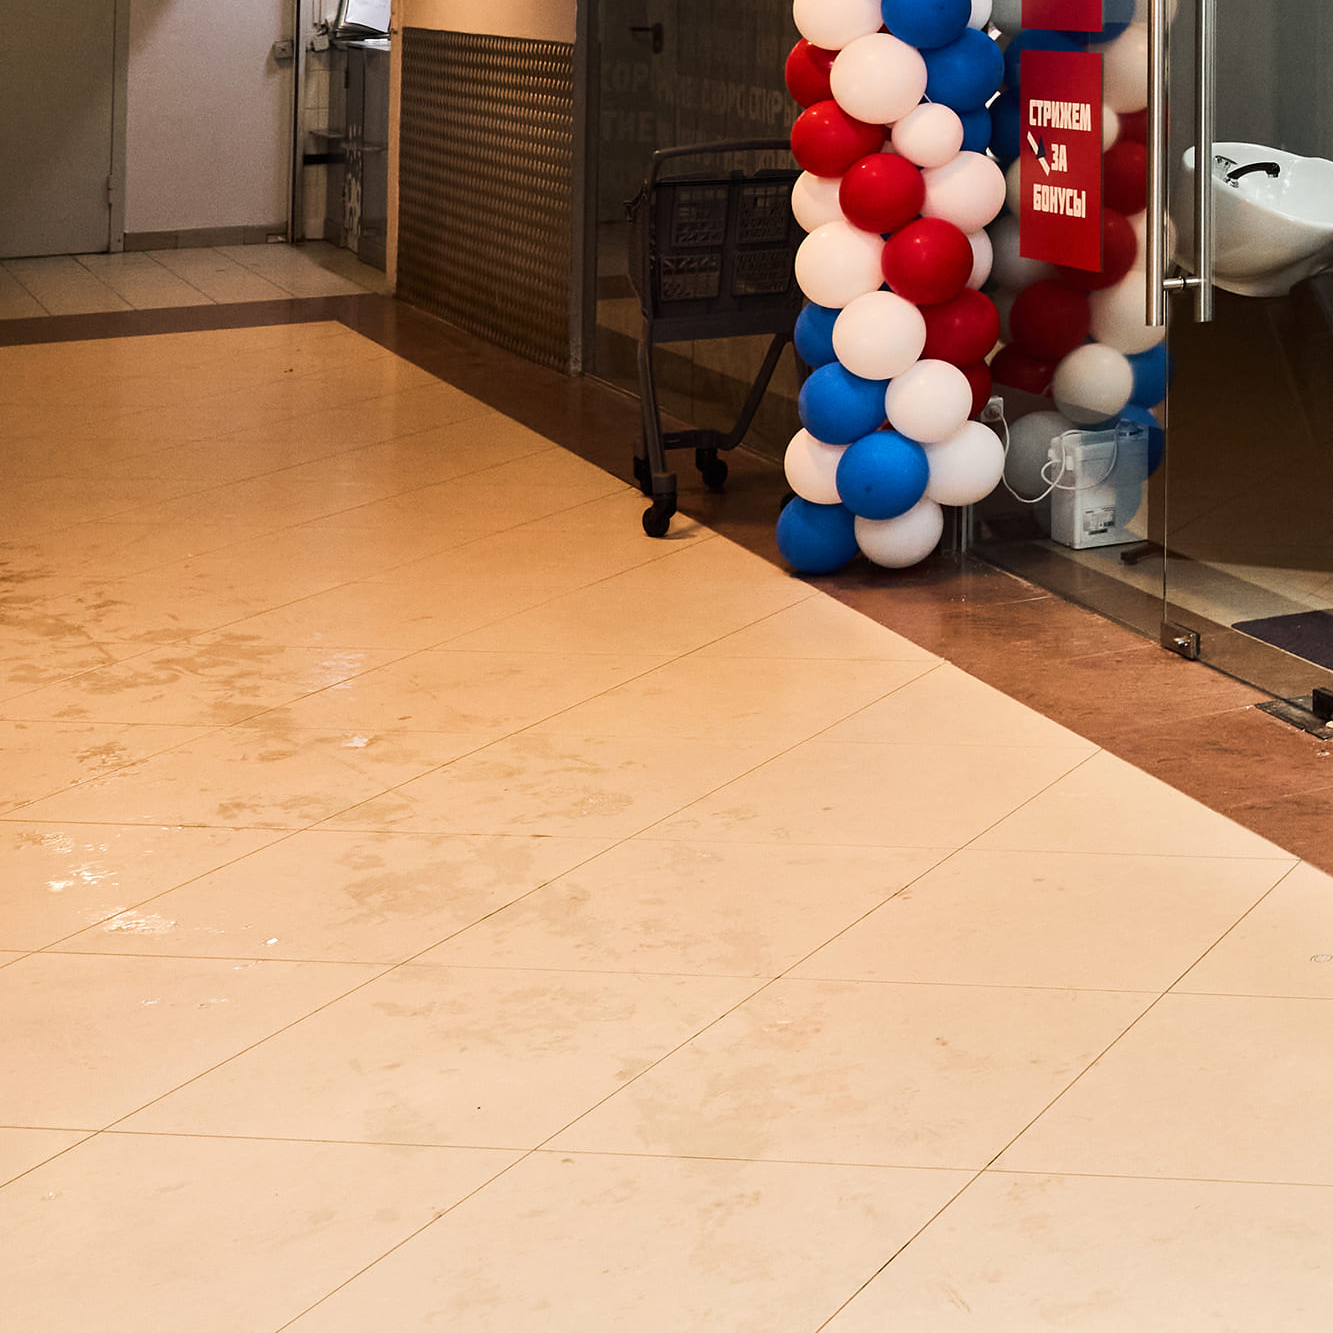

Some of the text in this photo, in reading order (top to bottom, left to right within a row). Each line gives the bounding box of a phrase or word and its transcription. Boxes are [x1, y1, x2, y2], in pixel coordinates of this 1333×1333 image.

[1029, 99, 1091, 131] СТРИЖЕМ
[1051, 144, 1067, 172] ЗА
[1033, 183, 1086, 218] БОНУСЫ
